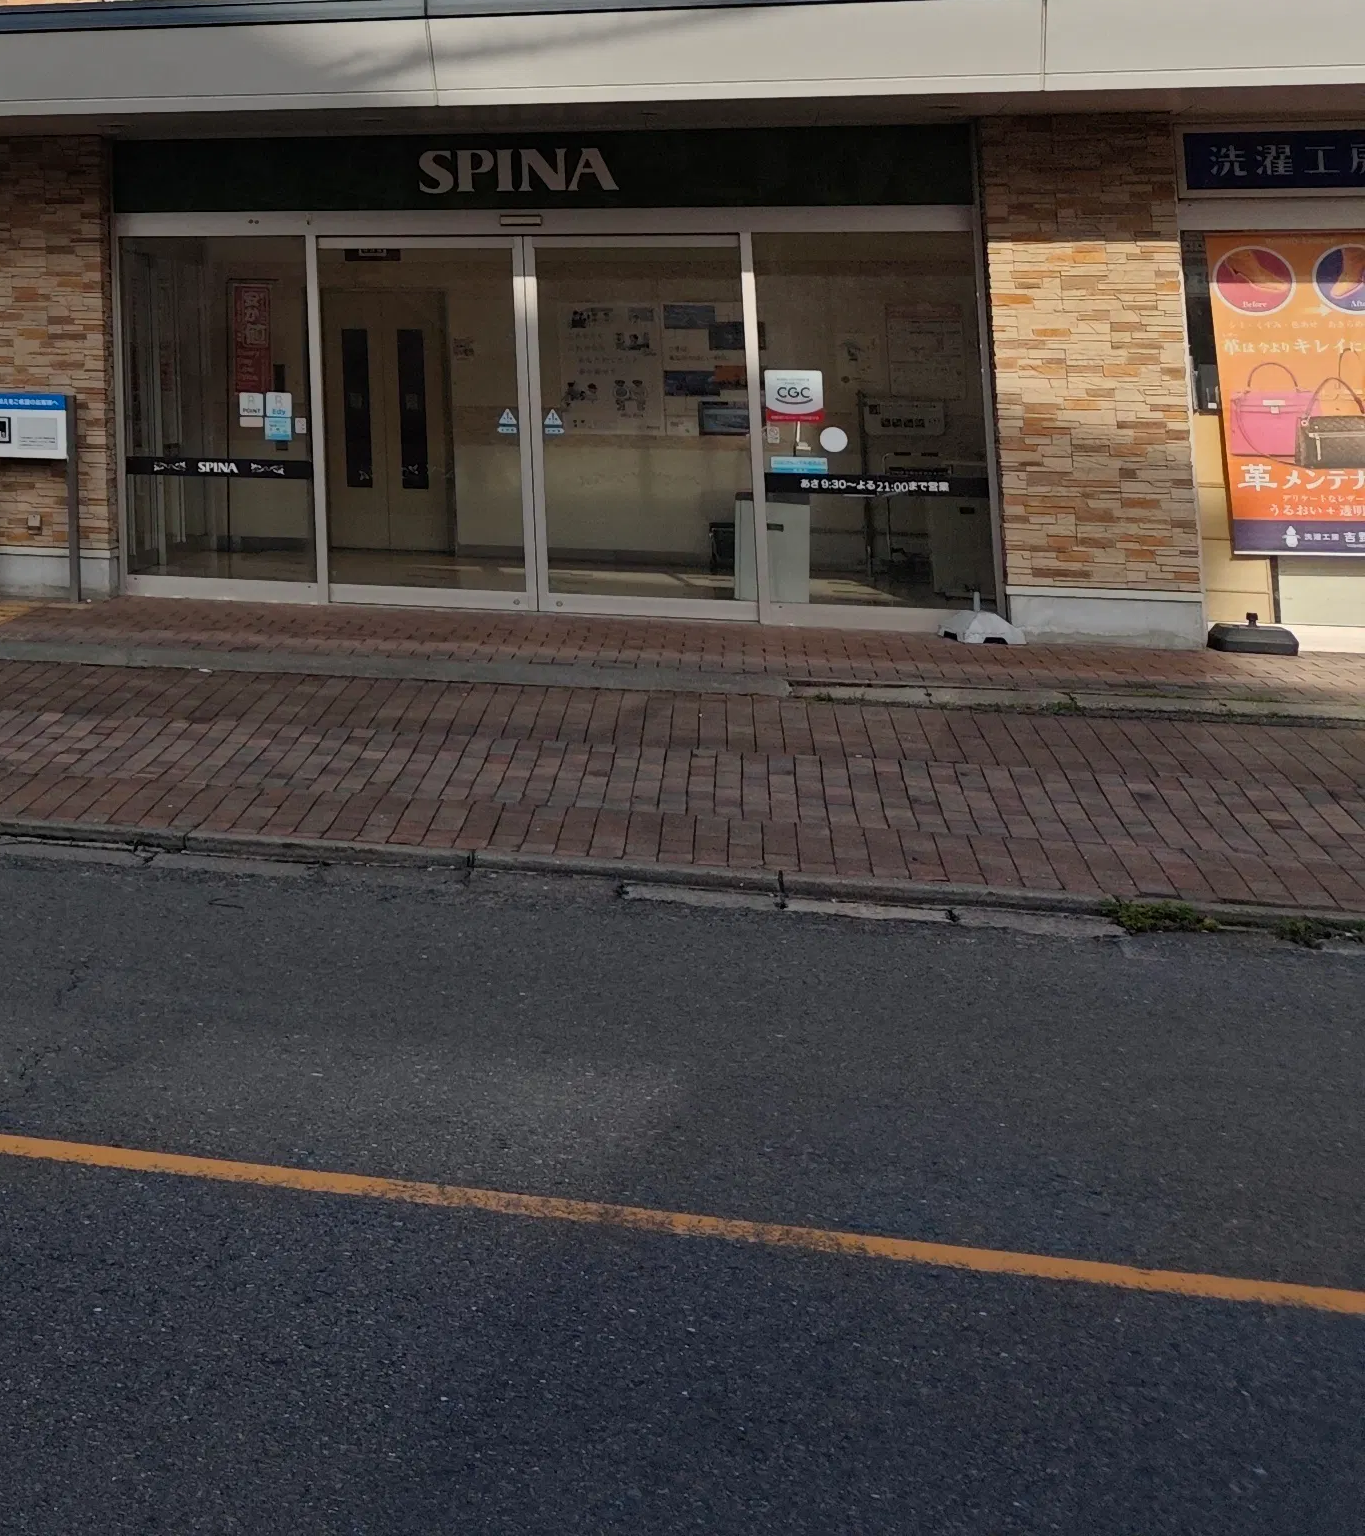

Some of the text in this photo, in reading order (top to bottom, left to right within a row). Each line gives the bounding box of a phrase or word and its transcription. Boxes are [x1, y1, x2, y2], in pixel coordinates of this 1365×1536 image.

[419, 148, 619, 194] SPINA
[1243, 300, 1267, 308] Before
[777, 386, 811, 399] CGC
[272, 407, 286, 415] Edy
[198, 461, 239, 473] SPINA
